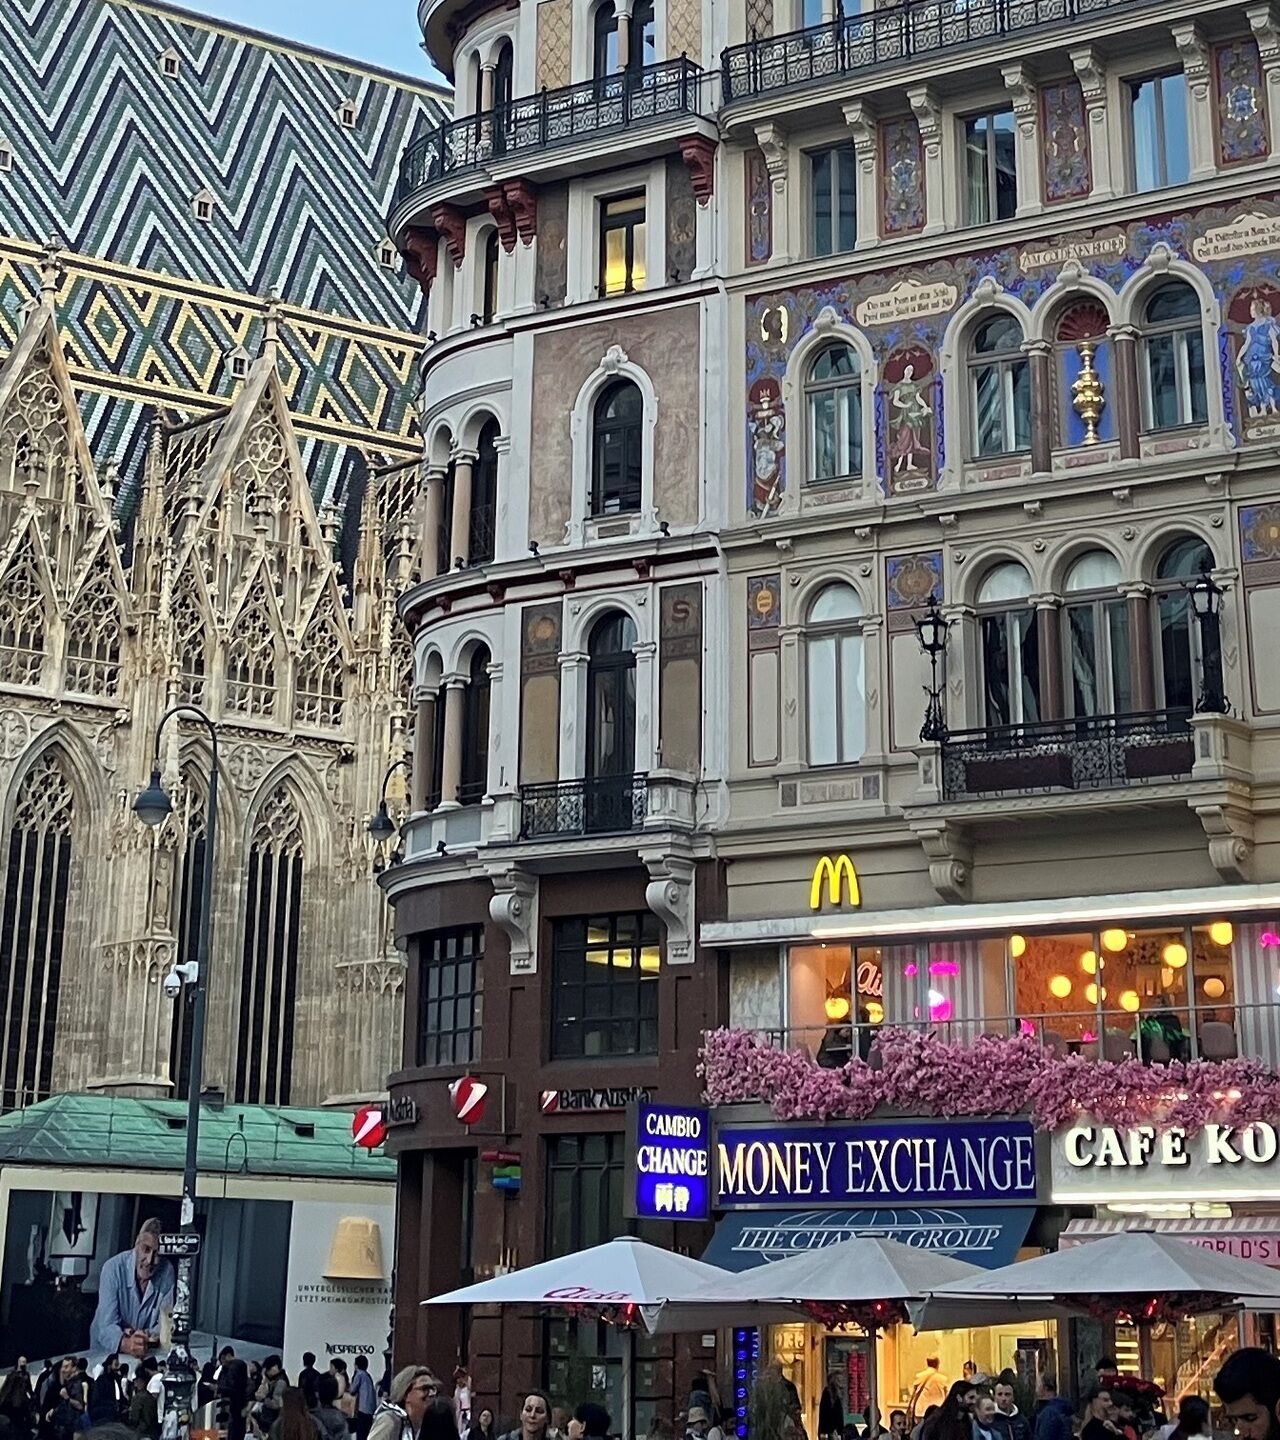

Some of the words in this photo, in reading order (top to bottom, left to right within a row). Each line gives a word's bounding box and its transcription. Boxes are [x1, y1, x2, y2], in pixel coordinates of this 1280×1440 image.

[560, 1090, 596, 1109] Bank
[646, 1113, 701, 1138] CAMBIO
[637, 1146, 708, 1176] CHANGE
[718, 1142, 837, 1196] MONEY
[846, 1135, 1036, 1193] EXCHANGE
[738, 1229, 784, 1248] THE
[907, 1228, 1001, 1248] GROUP
[294, 1295, 319, 1303] JETZT
[378, 1286, 392, 1295] KA
[325, 1343, 375, 1355] NESPRESSO
